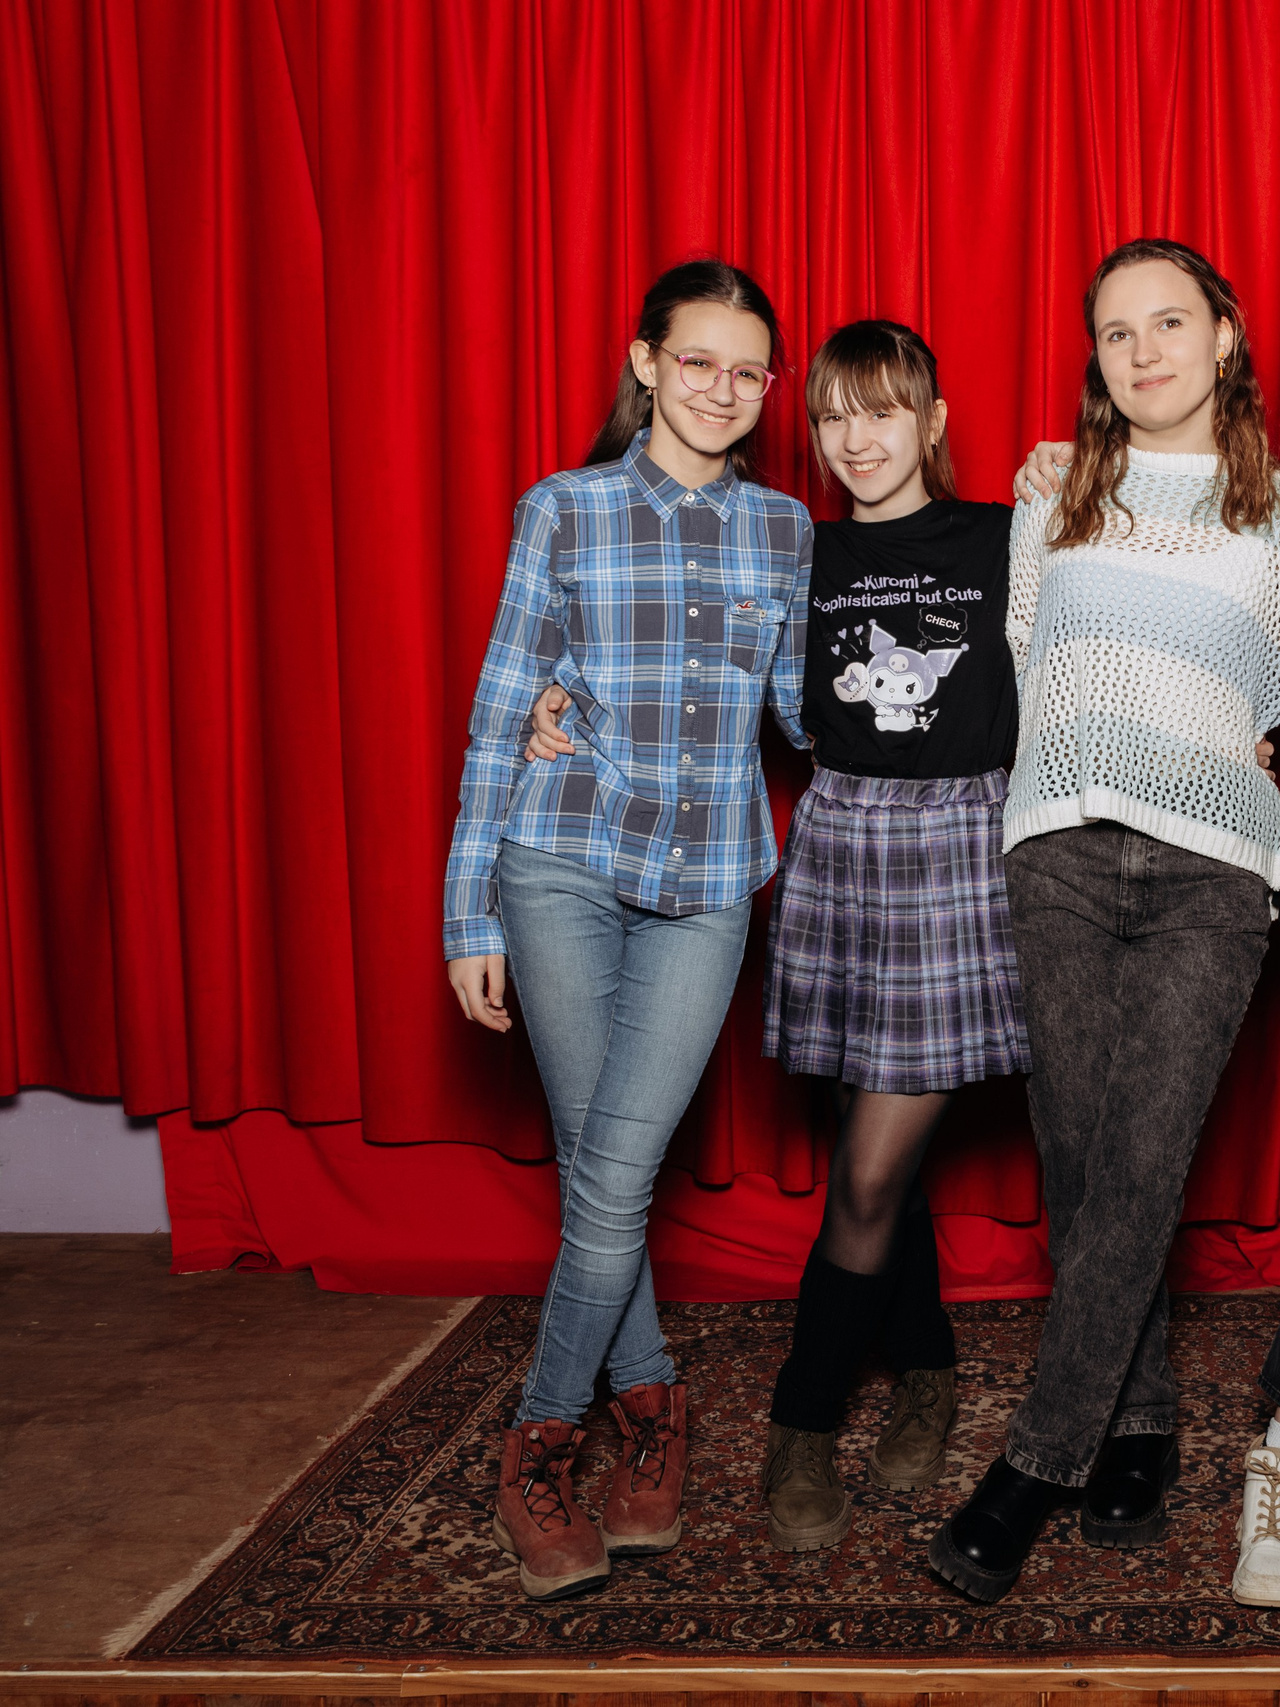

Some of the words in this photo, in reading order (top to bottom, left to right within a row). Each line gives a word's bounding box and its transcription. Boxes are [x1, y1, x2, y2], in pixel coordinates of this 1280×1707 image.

[864, 574, 919, 590] Kuromi
[915, 589, 942, 604] but
[945, 587, 982, 602] Cute
[925, 614, 961, 631] CHECK
